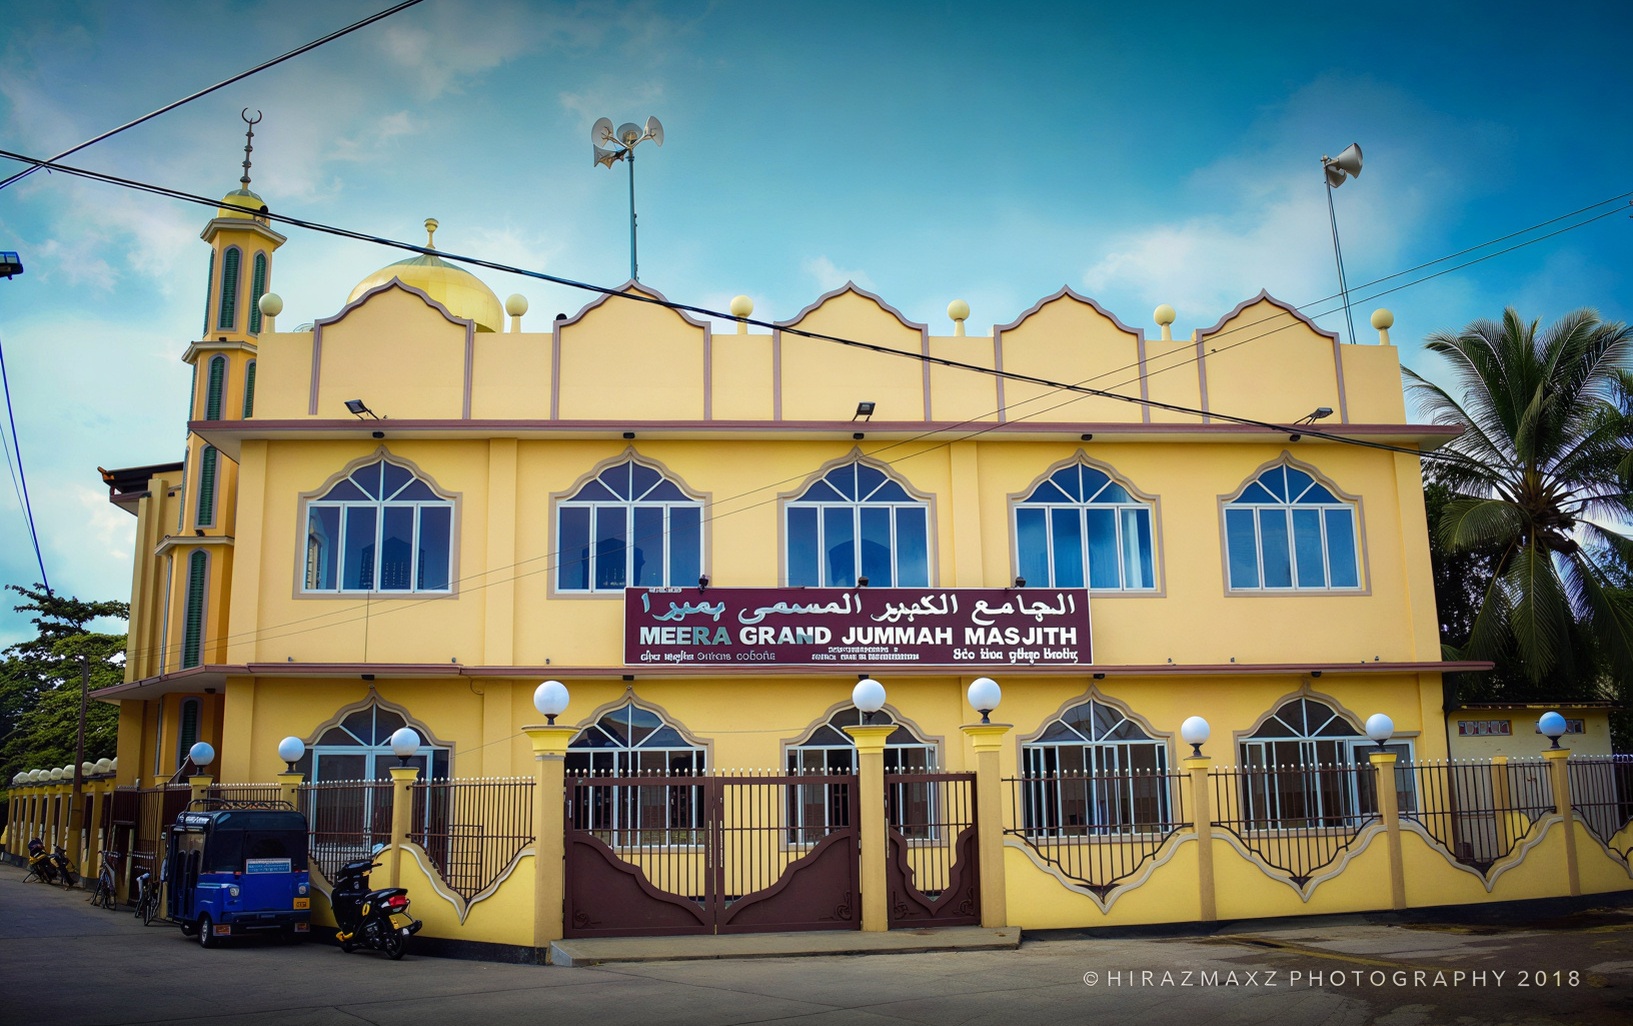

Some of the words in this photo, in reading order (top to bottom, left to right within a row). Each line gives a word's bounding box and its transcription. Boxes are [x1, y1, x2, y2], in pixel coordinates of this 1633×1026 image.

[738, 592, 861, 625] المسمى
[870, 592, 959, 622] الكبير
[971, 592, 1076, 626] الجامع
[639, 626, 733, 646] MEERA
[739, 626, 833, 646] GRAND
[841, 626, 953, 647] JUMMAH
[965, 626, 1078, 646] MASJITH
